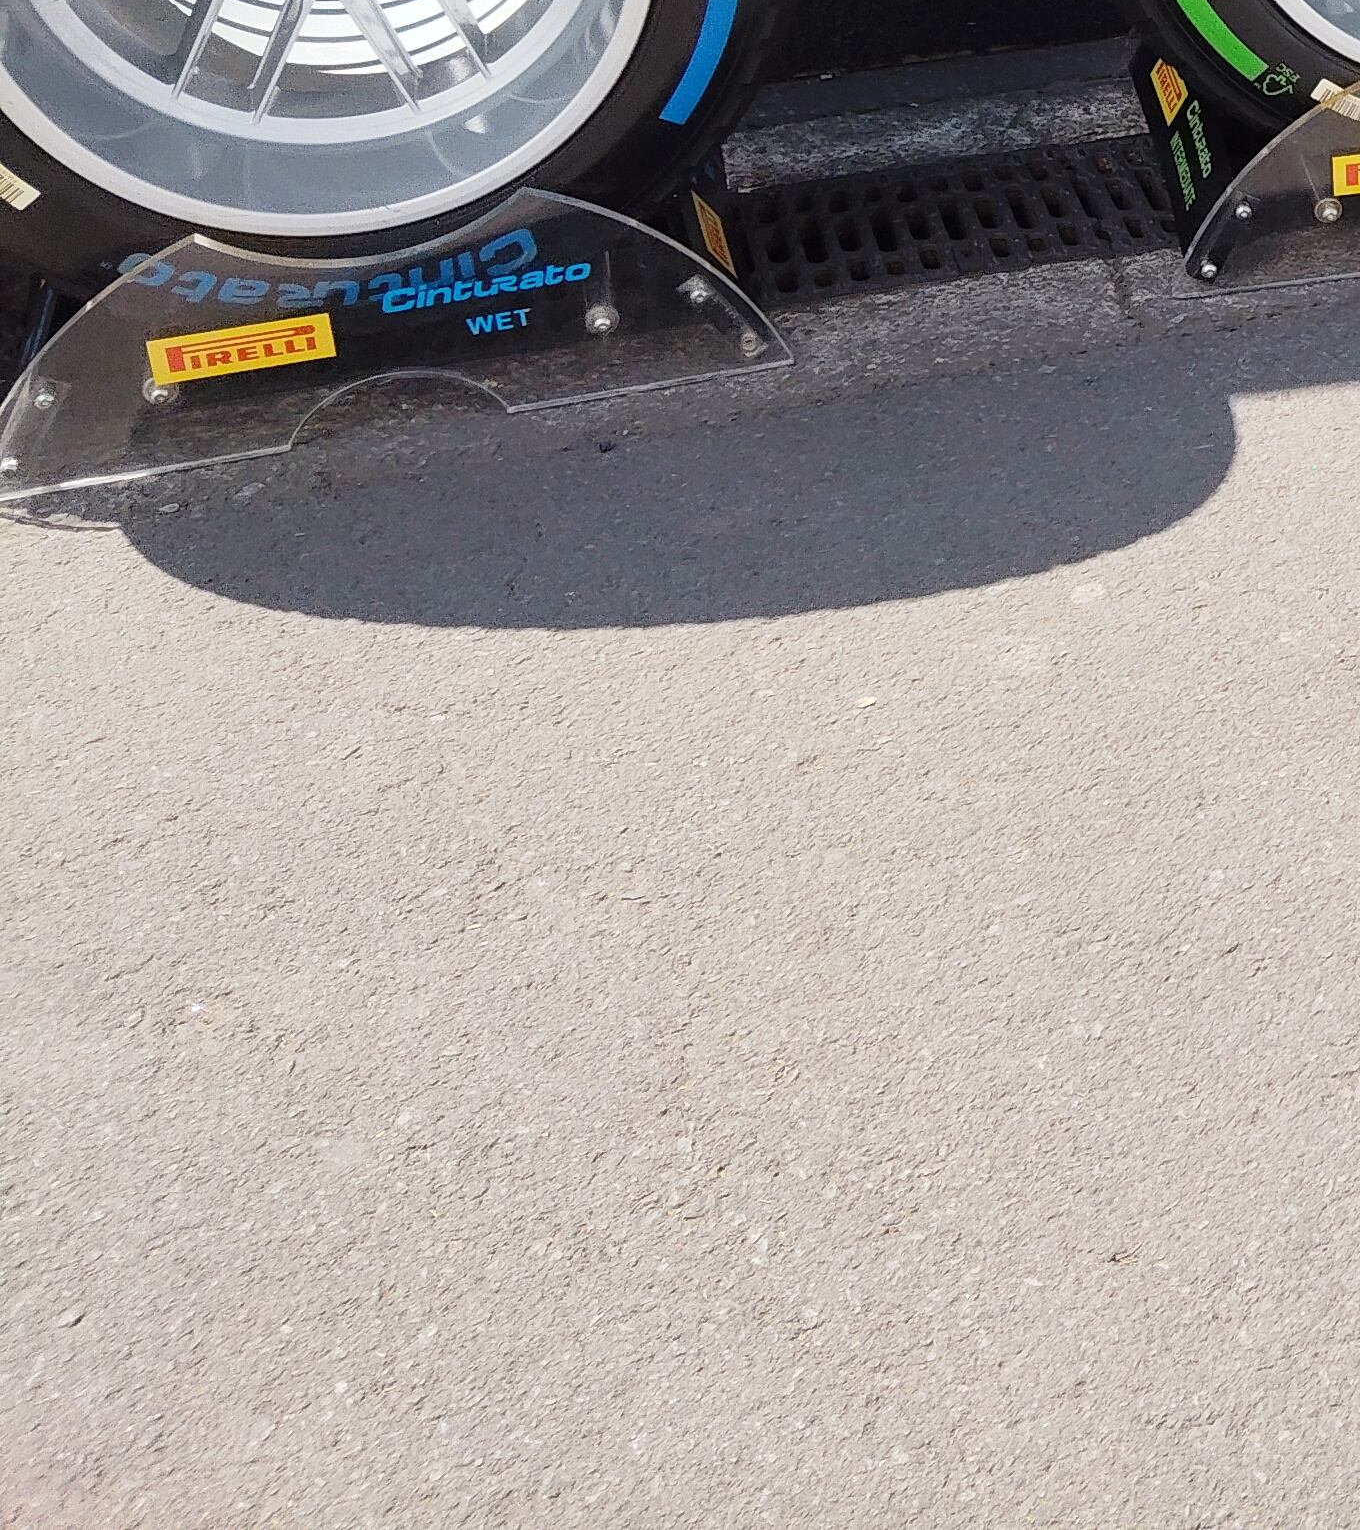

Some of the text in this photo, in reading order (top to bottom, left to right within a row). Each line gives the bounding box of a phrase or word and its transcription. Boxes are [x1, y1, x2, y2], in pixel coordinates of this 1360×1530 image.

[381, 261, 592, 314] Cinturato
[465, 308, 533, 336] WET
[164, 325, 316, 373] PIRELLI
